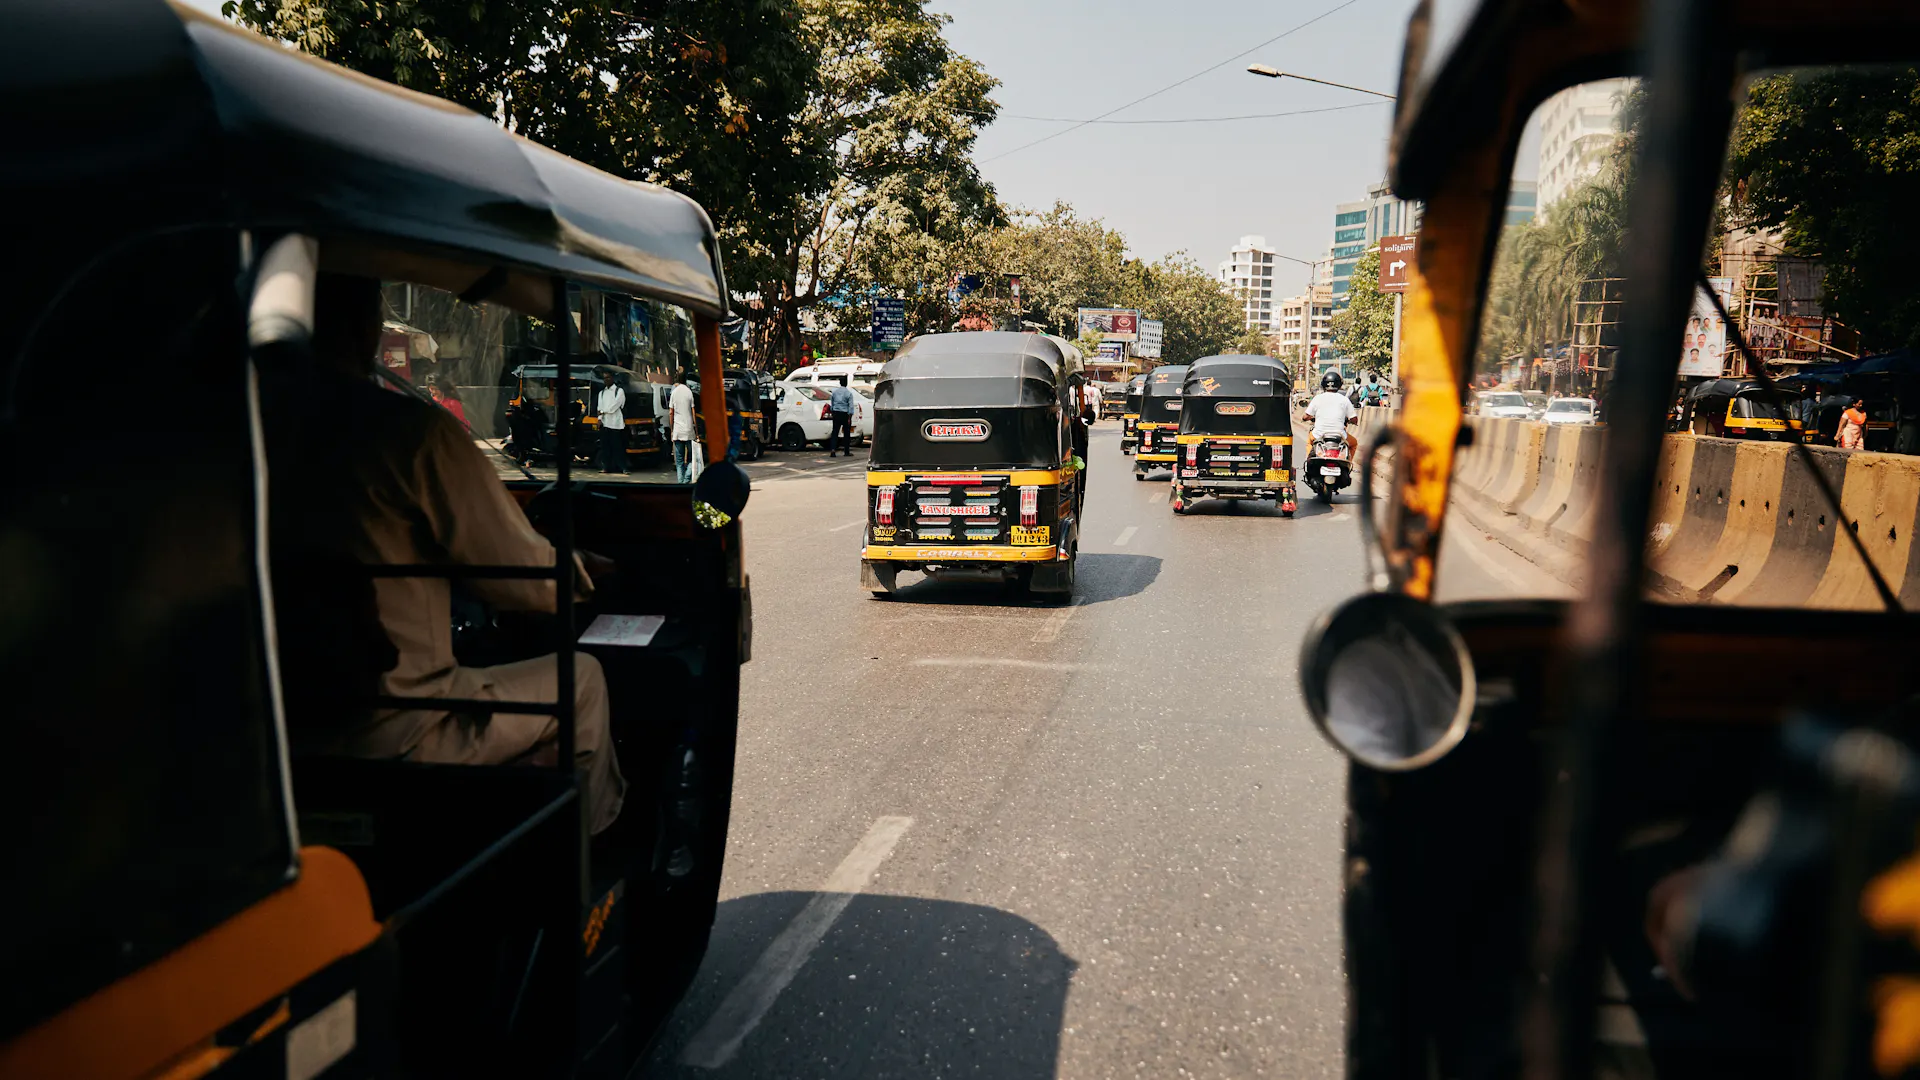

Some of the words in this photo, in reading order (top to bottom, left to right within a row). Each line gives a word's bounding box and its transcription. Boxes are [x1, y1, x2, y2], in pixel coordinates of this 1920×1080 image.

[1384, 244, 1413, 252] solitaire
[931, 424, 984, 436] RITIKA
[919, 504, 991, 515] TANUSHREE
[873, 526, 897, 537] STOP
